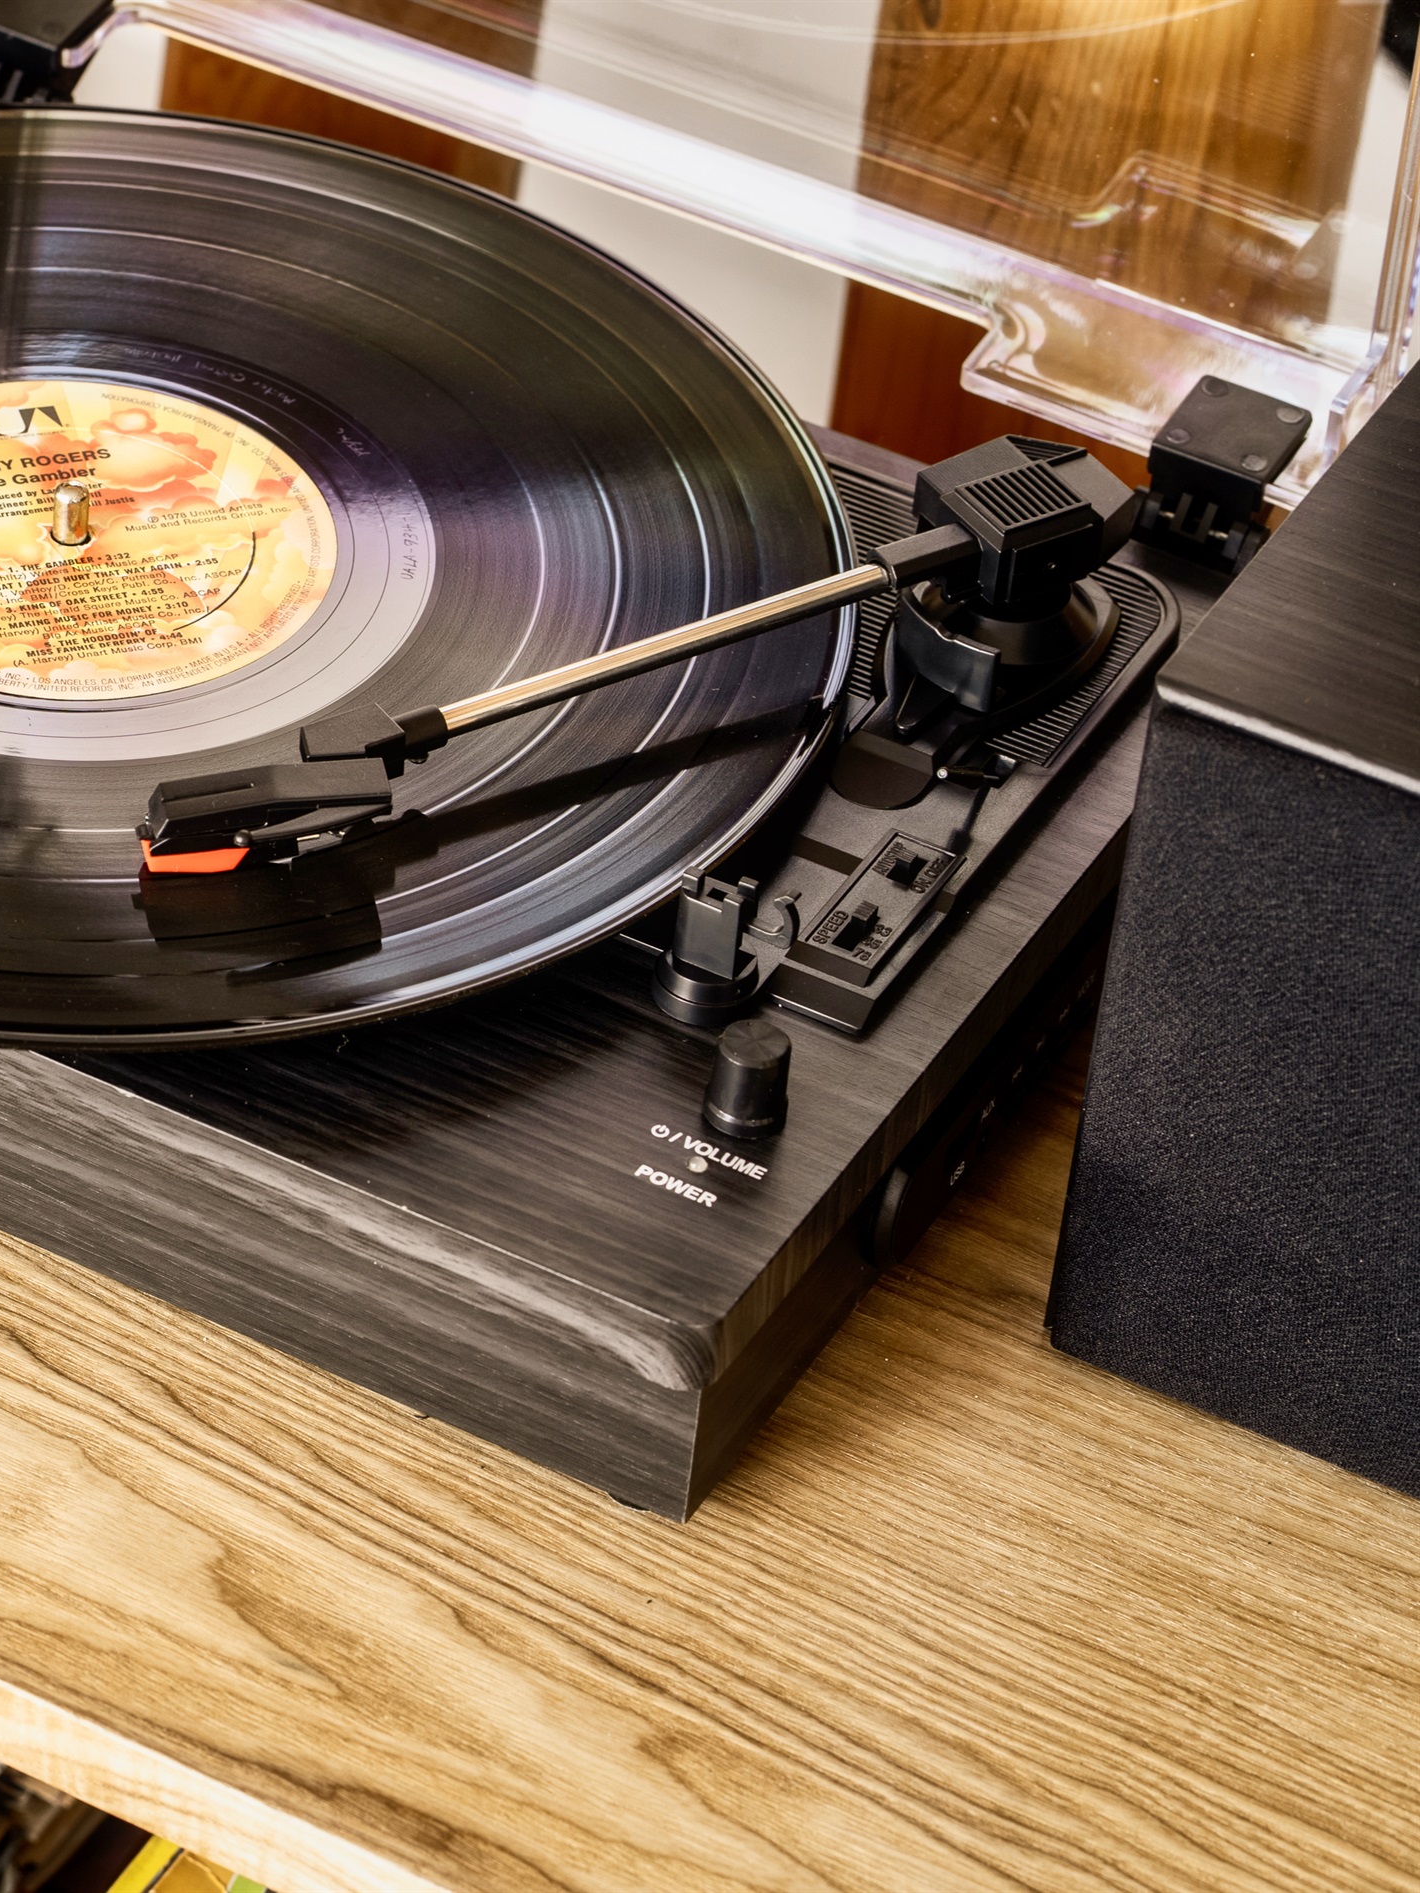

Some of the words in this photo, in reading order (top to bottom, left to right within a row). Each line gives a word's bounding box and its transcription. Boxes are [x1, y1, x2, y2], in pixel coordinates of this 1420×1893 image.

[20, 449, 112, 468] ROGERS
[11, 467, 97, 485] Gambler
[26, 490, 38, 499] by
[105, 497, 136, 506] Justis
[125, 523, 158, 533] Music
[160, 520, 180, 528] and
[184, 515, 228, 526] Records
[270, 505, 292, 514] Inc.
[161, 511, 187, 521] 1978
[189, 507, 226, 518] United
[229, 502, 264, 512] Artists
[8, 566, 19, 574] 1.
[21, 563, 42, 572] THE
[45, 556, 95, 568] GAMBLER
[105, 552, 131, 561] 3:32
[26, 577, 61, 587] COULD
[63, 572, 91, 583] HURT
[92, 569, 121, 579] THAT
[123, 566, 146, 575] WAY
[150, 562, 183, 572] AGAIN
[195, 557, 219, 566] 2:55
[29, 567, 70, 578] Writers
[71, 563, 104, 573] Night
[141, 553, 179, 564] ASCAP
[307, 554, 321, 578] ARTISTS
[10, 583, 71, 596] VanHoy/D.
[73, 578, 119, 589] Cook/C.
[121, 571, 167, 582] Putman)
[30, 587, 91, 602] BMI/Cross
[93, 585, 119, 594] Keys
[121, 580, 150, 590] Publ.
[179, 575, 201, 583] Inc.
[204, 568, 242, 579] ASCAP
[300, 578, 316, 599] UNITED
[5, 606, 17, 614] 3.
[18, 602, 46, 612] KING
[49, 600, 62, 608] OF
[65, 596, 87, 606] OAK
[89, 591, 128, 603] STREET
[141, 587, 165, 596] 4:55
[20, 611, 41, 619] The
[43, 605, 81, 616] Herald
[83, 601, 122, 612] Square
[124, 596, 157, 605] Music
[160, 593, 180, 601] Co.
[183, 587, 221, 598] ASCAP
[290, 597, 306, 612] WITH
[8, 618, 52, 629] MAKING
[53, 613, 90, 624] MUSIC
[91, 610, 113, 619] FOR
[115, 605, 152, 616] MONEY
[164, 601, 189, 610] 3:10
[43, 622, 80, 633] United
[83, 618, 118, 627] Artists
[120, 613, 155, 622] Music
[263, 610, 295, 640] AFFILIATED
[32, 676, 52, 685] LOS
[100, 671, 155, 686] CALIFORNIA
[155, 665, 184, 677] 90028
[188, 655, 215, 669] MADE
[213, 651, 224, 660] IN
[247, 629, 265, 640] ALL
[259, 610, 283, 630] RIGHTS
[276, 583, 302, 612] RESERVED
[42, 632, 62, 640] Big
[81, 626, 115, 638] Music
[117, 619, 156, 631] ASCAP
[58, 637, 81, 647] THE
[144, 628, 158, 636] OF
[12, 659, 29, 668] (A.
[32, 653, 74, 664] Harvey)
[77, 649, 109, 659] Unart
[110, 645, 144, 655] Music
[146, 640, 177, 650] Corp.
[180, 637, 203, 646] BMI
[26, 648, 54, 658] MISS
[57, 644, 96, 654] FANNIE
[160, 632, 183, 641] 4:44
[249, 636, 266, 649] NOT
[215, 646, 251, 667] COMPANY
[156, 664, 214, 685] INDEPENDENT
[910, 877, 932, 894] ON
[923, 857, 944, 879] OFF
[812, 910, 849, 945] SPEED
[873, 923, 893, 938] 33
[852, 946, 873, 962] 78
[862, 937, 883, 950] 45
[683, 1135, 768, 1180] VOLUME
[634, 1164, 718, 1208] POWER
